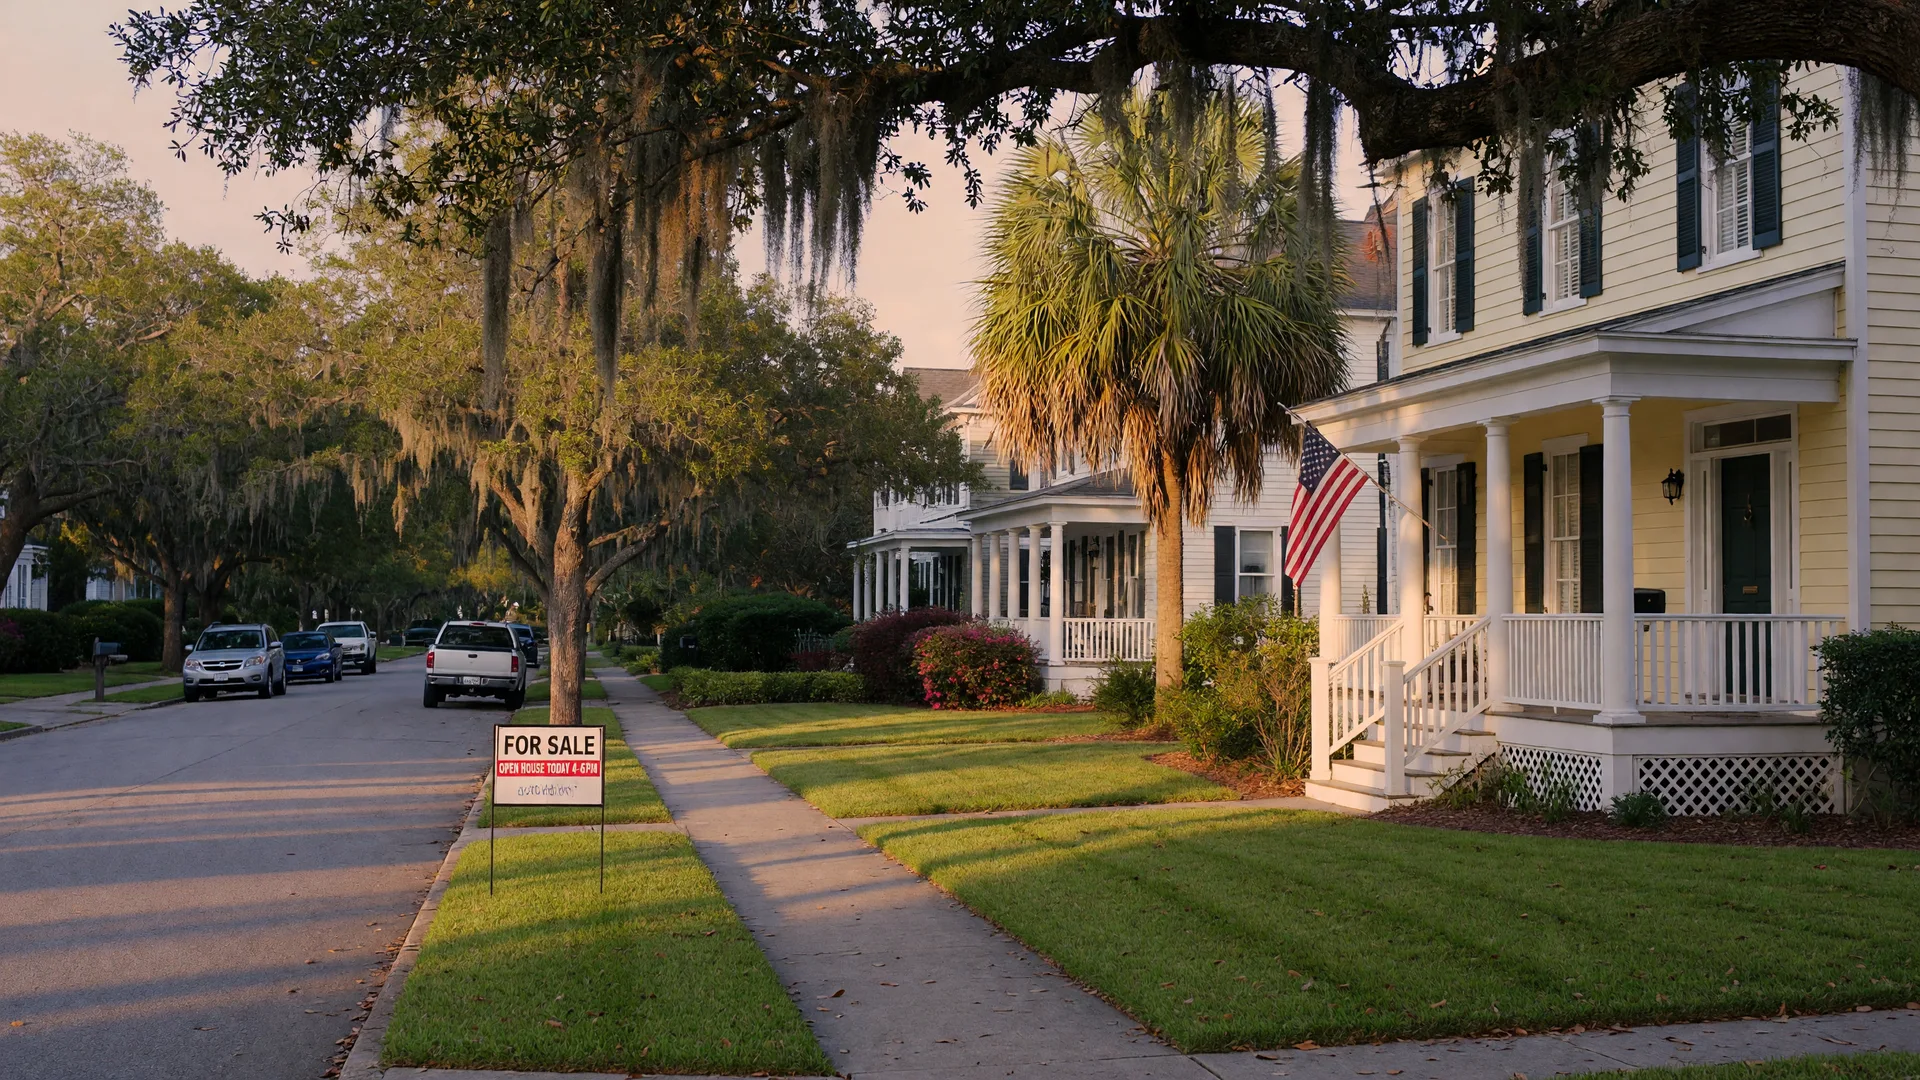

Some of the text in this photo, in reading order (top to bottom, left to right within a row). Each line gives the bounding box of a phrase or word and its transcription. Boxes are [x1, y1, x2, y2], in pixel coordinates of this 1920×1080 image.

[504, 735, 595, 755] FOR SALE
[499, 762, 598, 774] OPEN HOUSE TODAY 4-6PM
